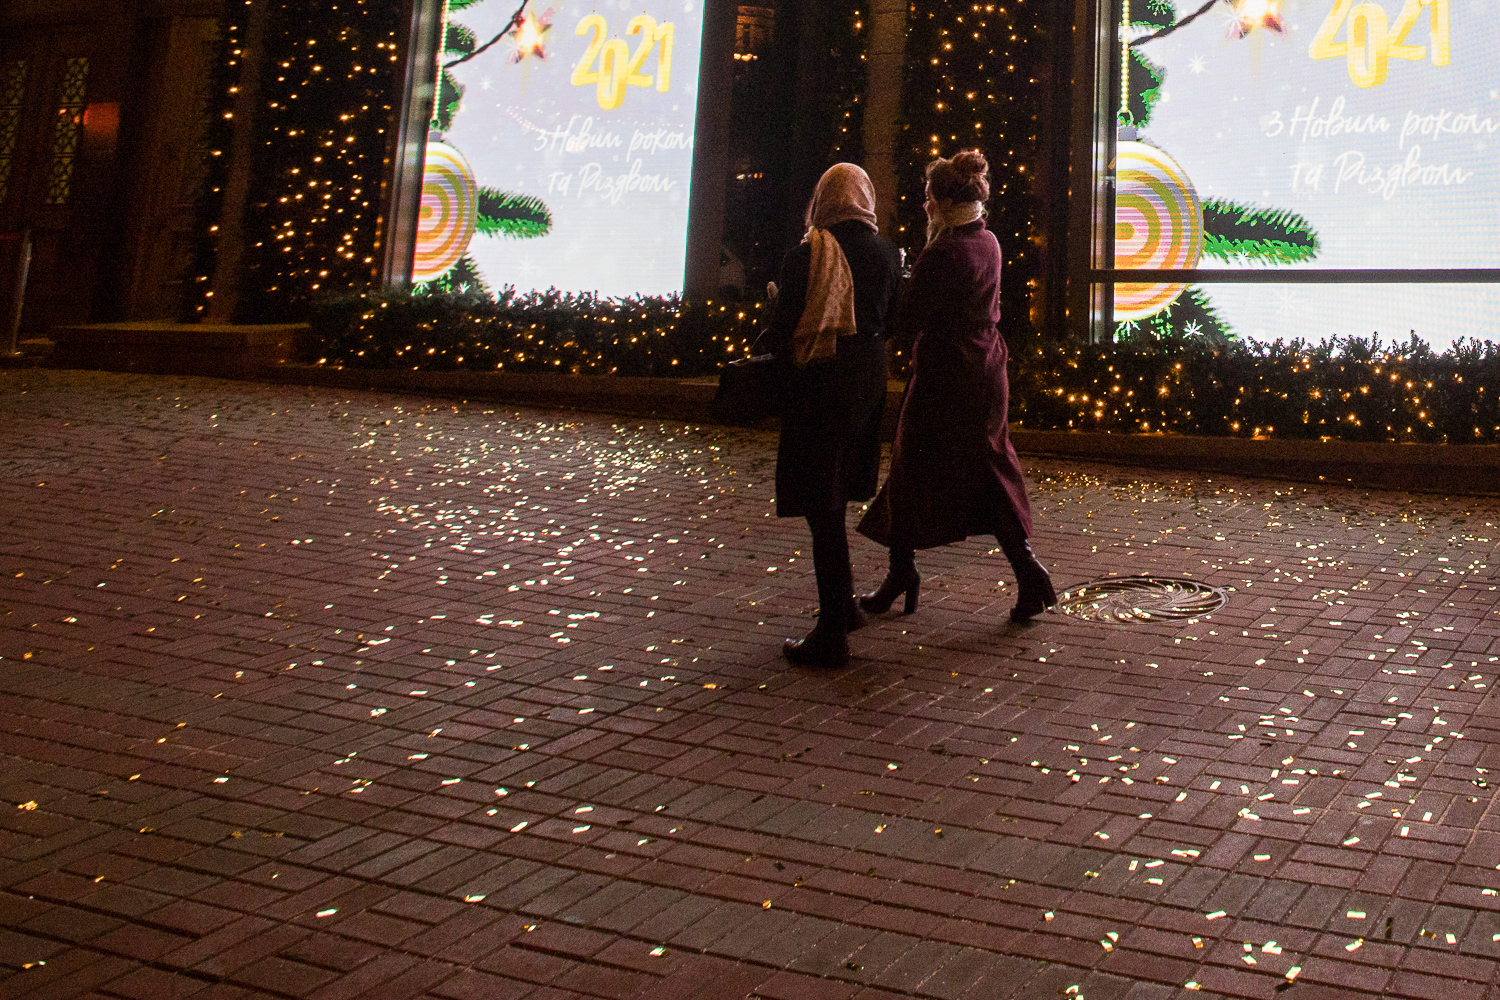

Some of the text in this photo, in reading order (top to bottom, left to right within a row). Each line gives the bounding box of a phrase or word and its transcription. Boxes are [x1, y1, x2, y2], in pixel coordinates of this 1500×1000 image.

[570, 14, 675, 111] 2021
[1265, 95, 1500, 150] з Новим роком
[1289, 144, 1474, 201] та Різдвом
